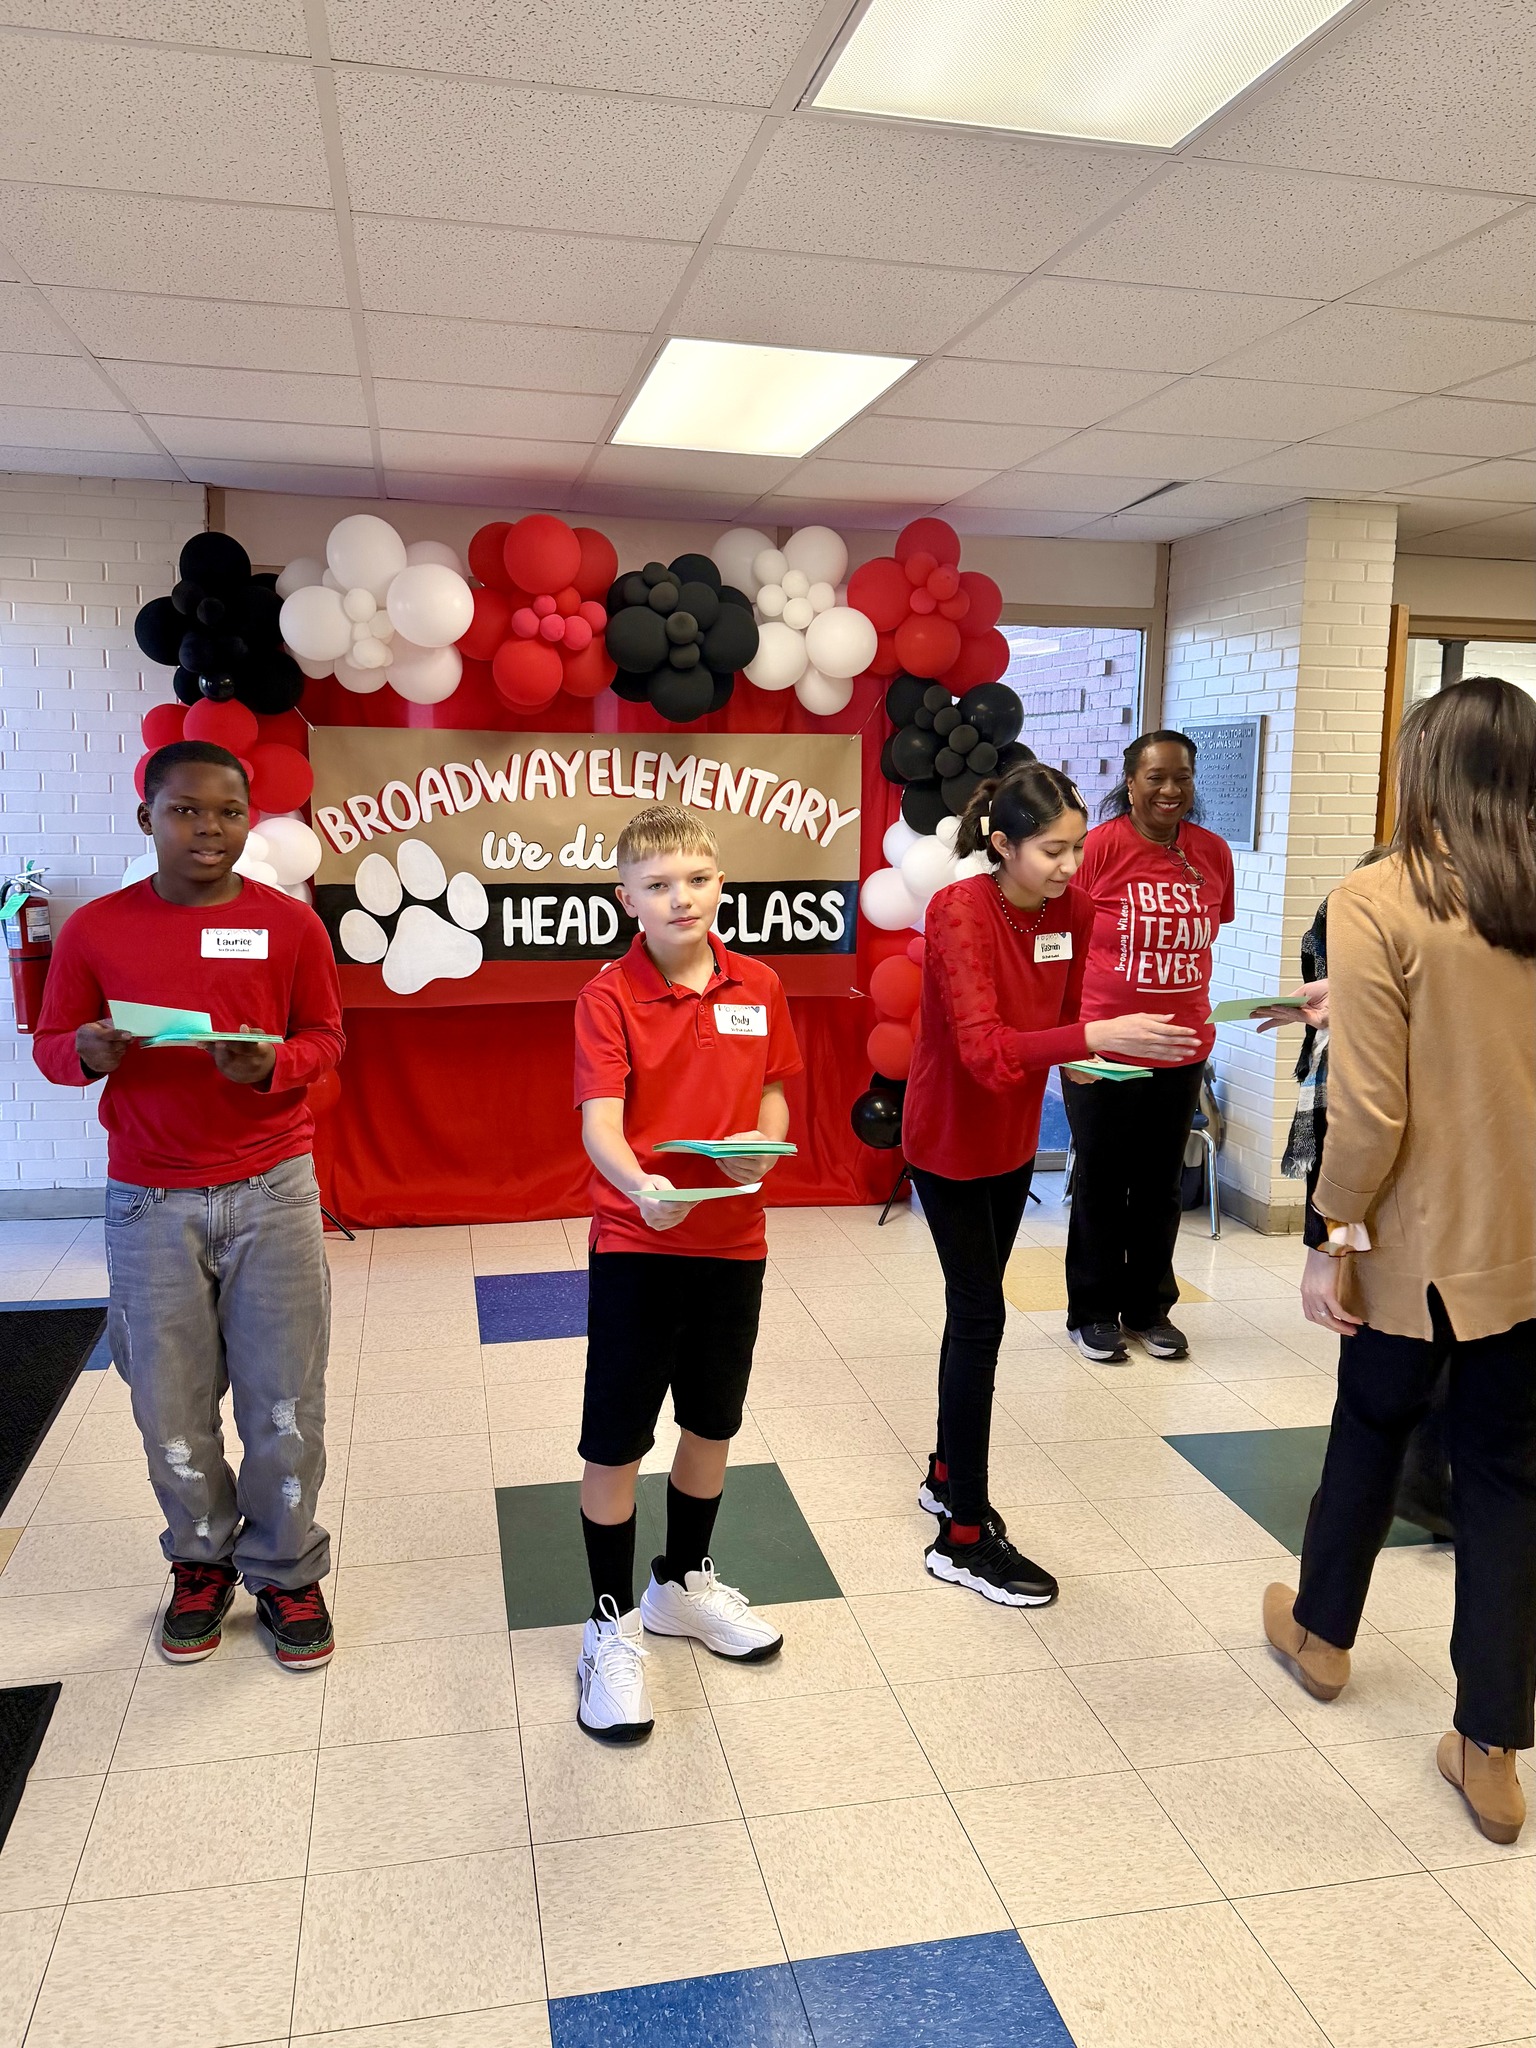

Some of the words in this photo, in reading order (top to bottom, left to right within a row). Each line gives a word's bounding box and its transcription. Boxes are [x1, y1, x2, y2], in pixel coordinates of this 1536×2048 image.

[1208, 739, 1242, 750] GYMNASIUM
[1217, 728, 1253, 740] AUDITORIUM
[315, 748, 584, 855] BROADWAY
[586, 747, 861, 848] ELEMENTARY
[481, 830, 552, 871] We
[502, 897, 618, 946] HEAD
[714, 890, 846, 944] CLASS
[1116, 897, 1129, 931] Wildcats
[1114, 934, 1129, 972] Broadway
[731, 1014, 750, 1026] Cody
